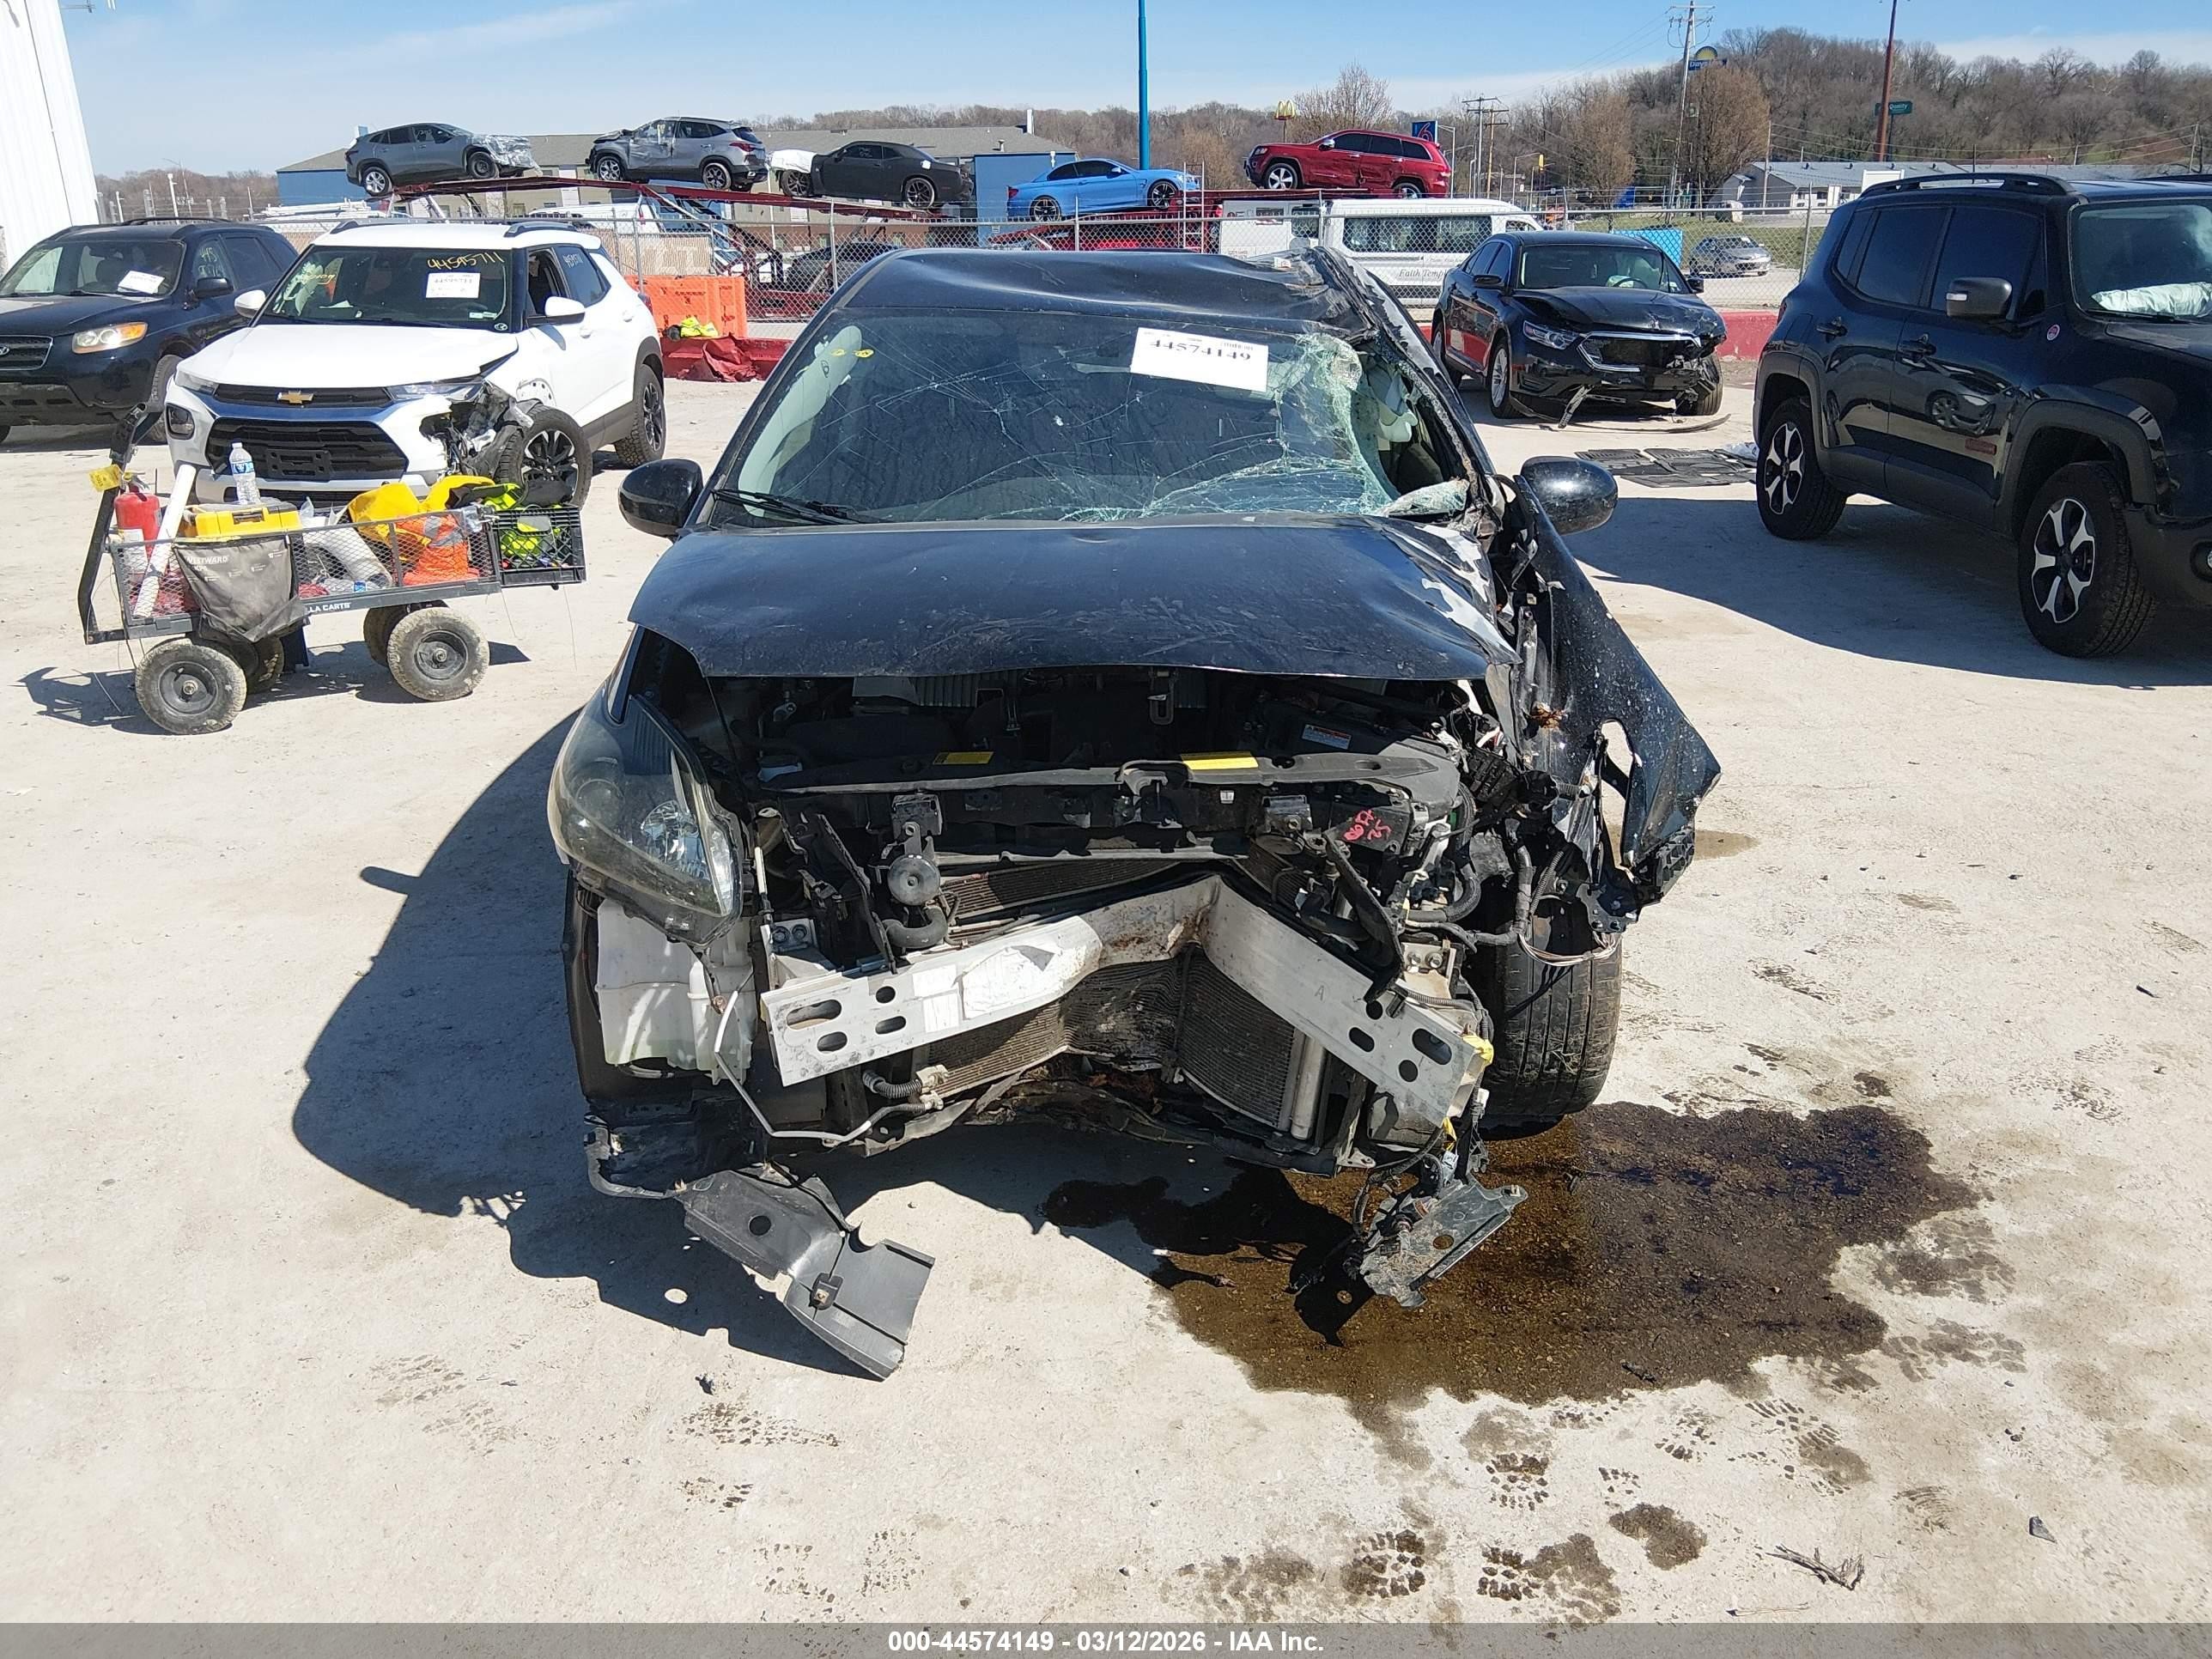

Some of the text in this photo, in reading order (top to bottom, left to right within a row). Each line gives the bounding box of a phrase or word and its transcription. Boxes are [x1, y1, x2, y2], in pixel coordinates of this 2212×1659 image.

[1418, 122, 1433, 143] 6
[427, 251, 505, 270] 44595711
[1150, 339, 1251, 361] 44574149
